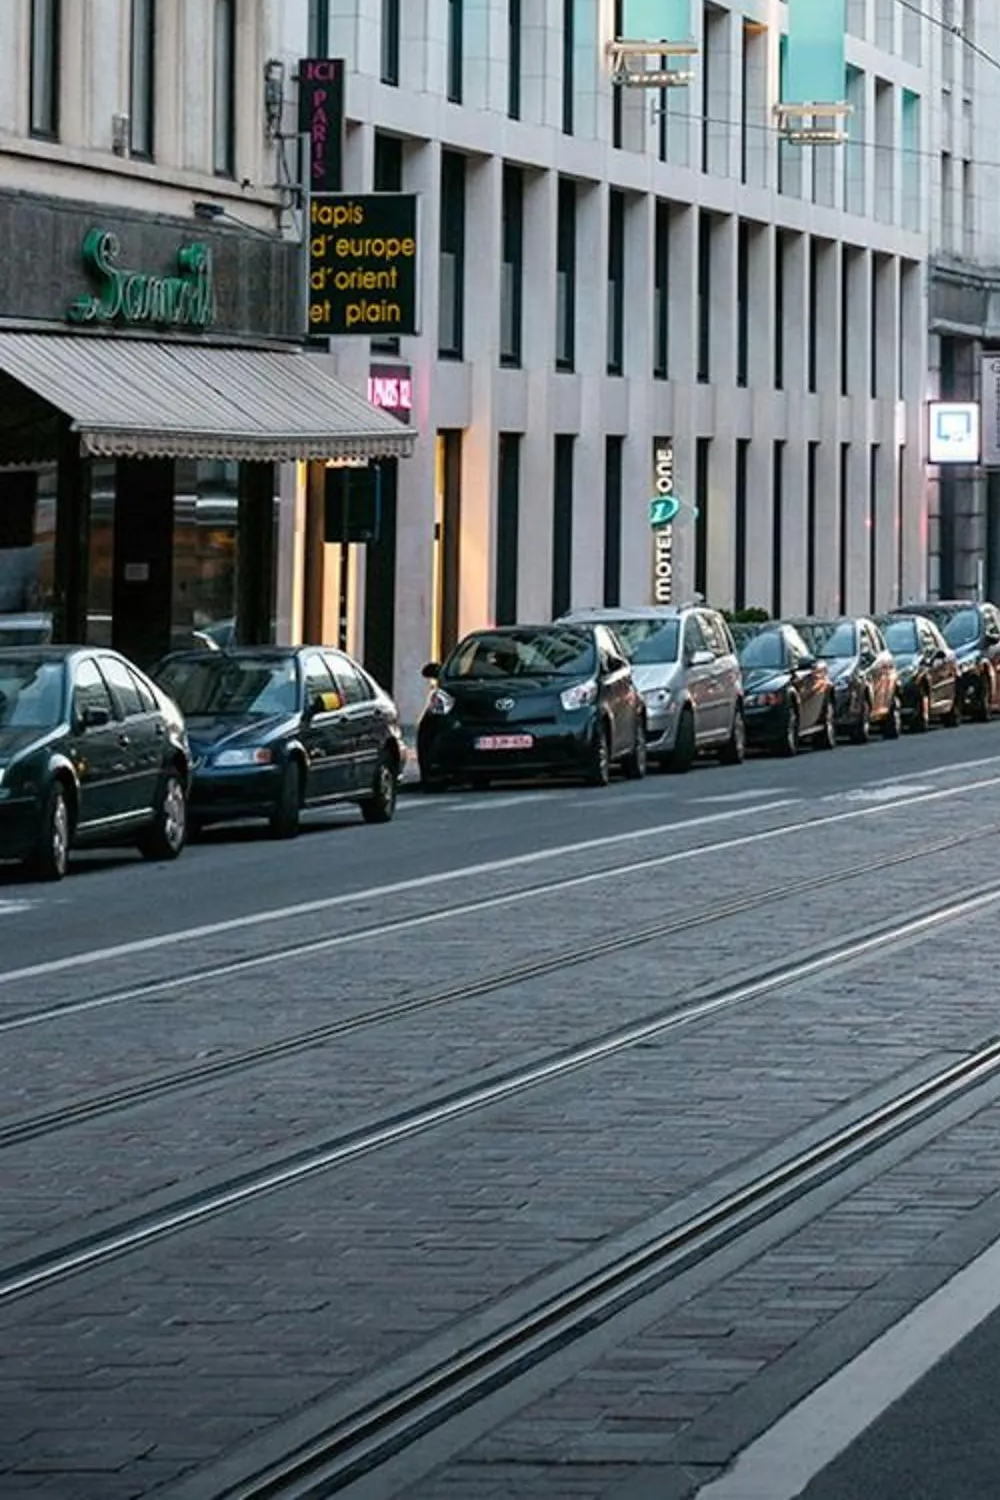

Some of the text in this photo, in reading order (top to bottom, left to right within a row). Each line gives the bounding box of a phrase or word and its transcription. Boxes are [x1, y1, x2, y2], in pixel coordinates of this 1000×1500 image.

[307, 62, 335, 80] ICI
[312, 88, 328, 178] PARIS
[311, 201, 363, 228] tapis
[309, 299, 401, 328] et plain
[656, 449, 673, 493] ONE
[655, 525, 673, 602] MOTEL
